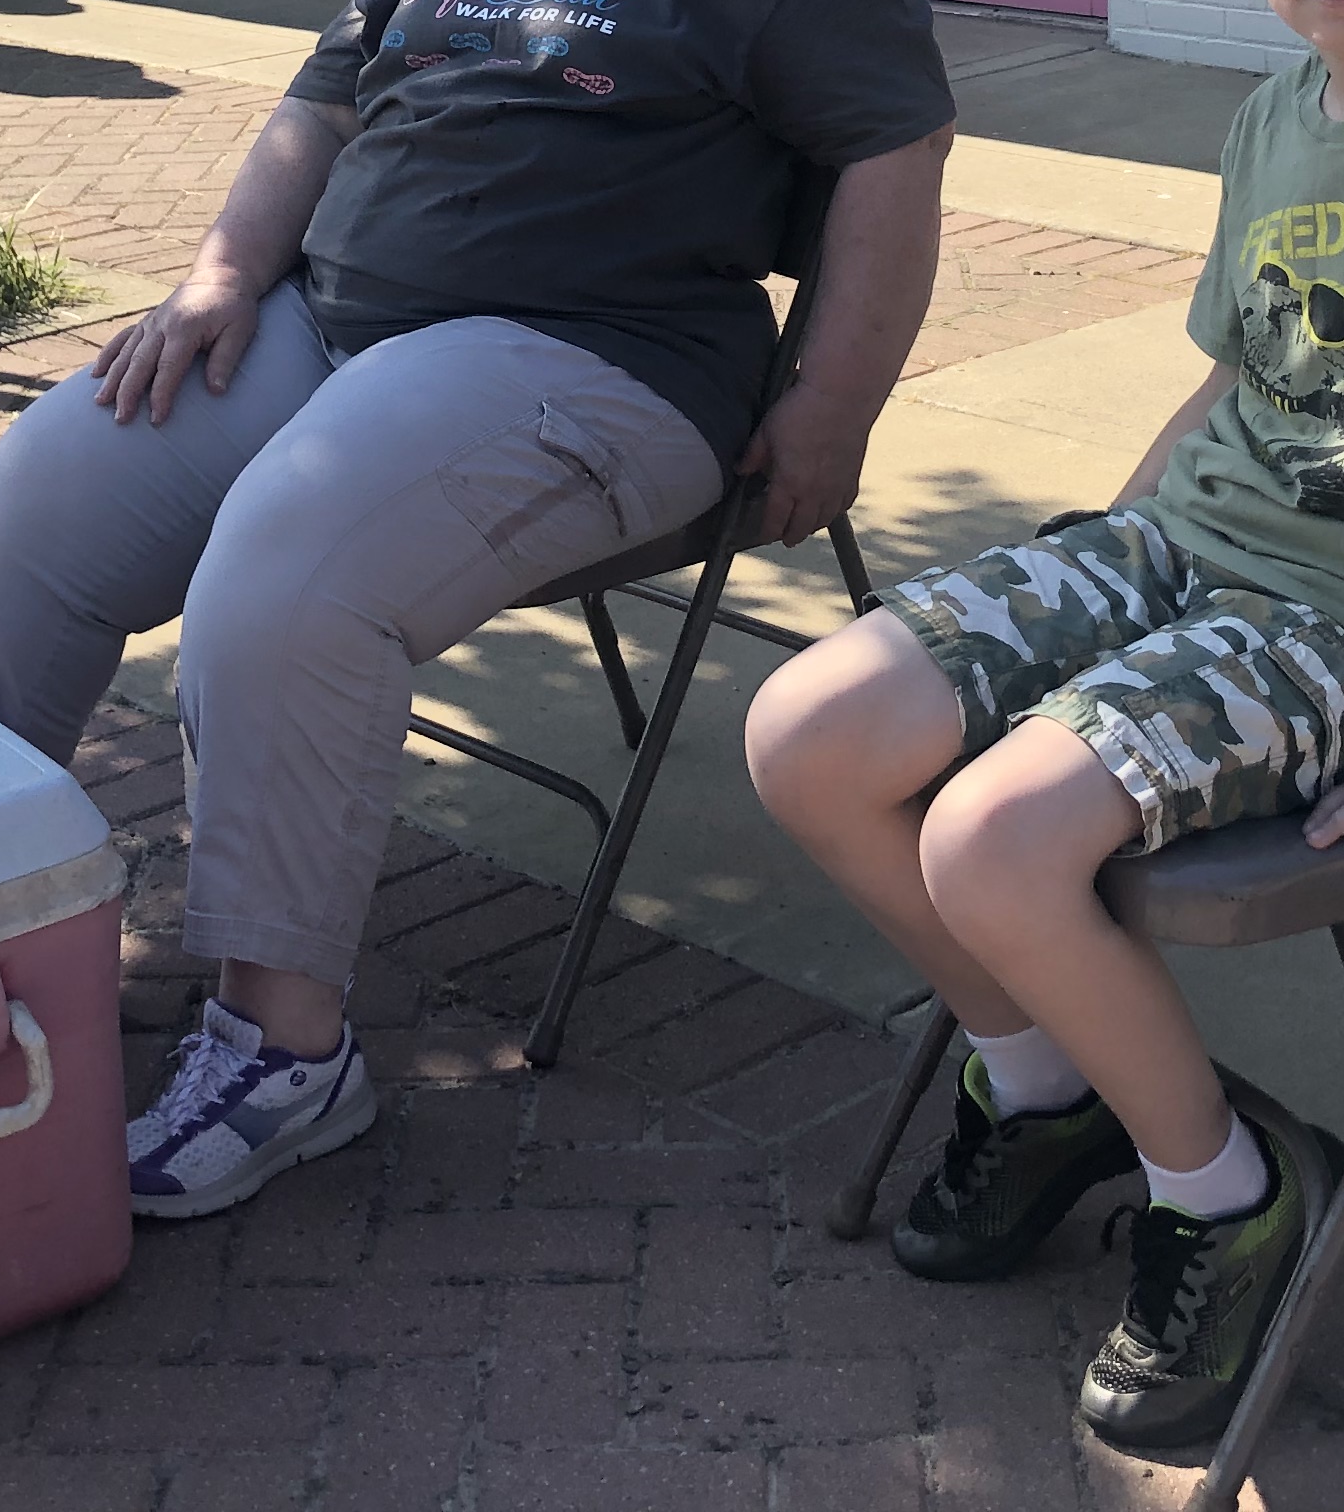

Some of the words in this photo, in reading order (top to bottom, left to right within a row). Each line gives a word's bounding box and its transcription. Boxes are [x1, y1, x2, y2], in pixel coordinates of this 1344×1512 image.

[455, 1, 518, 20] WALK
[517, 6, 560, 22] FOR
[563, 10, 617, 36] LIFE
